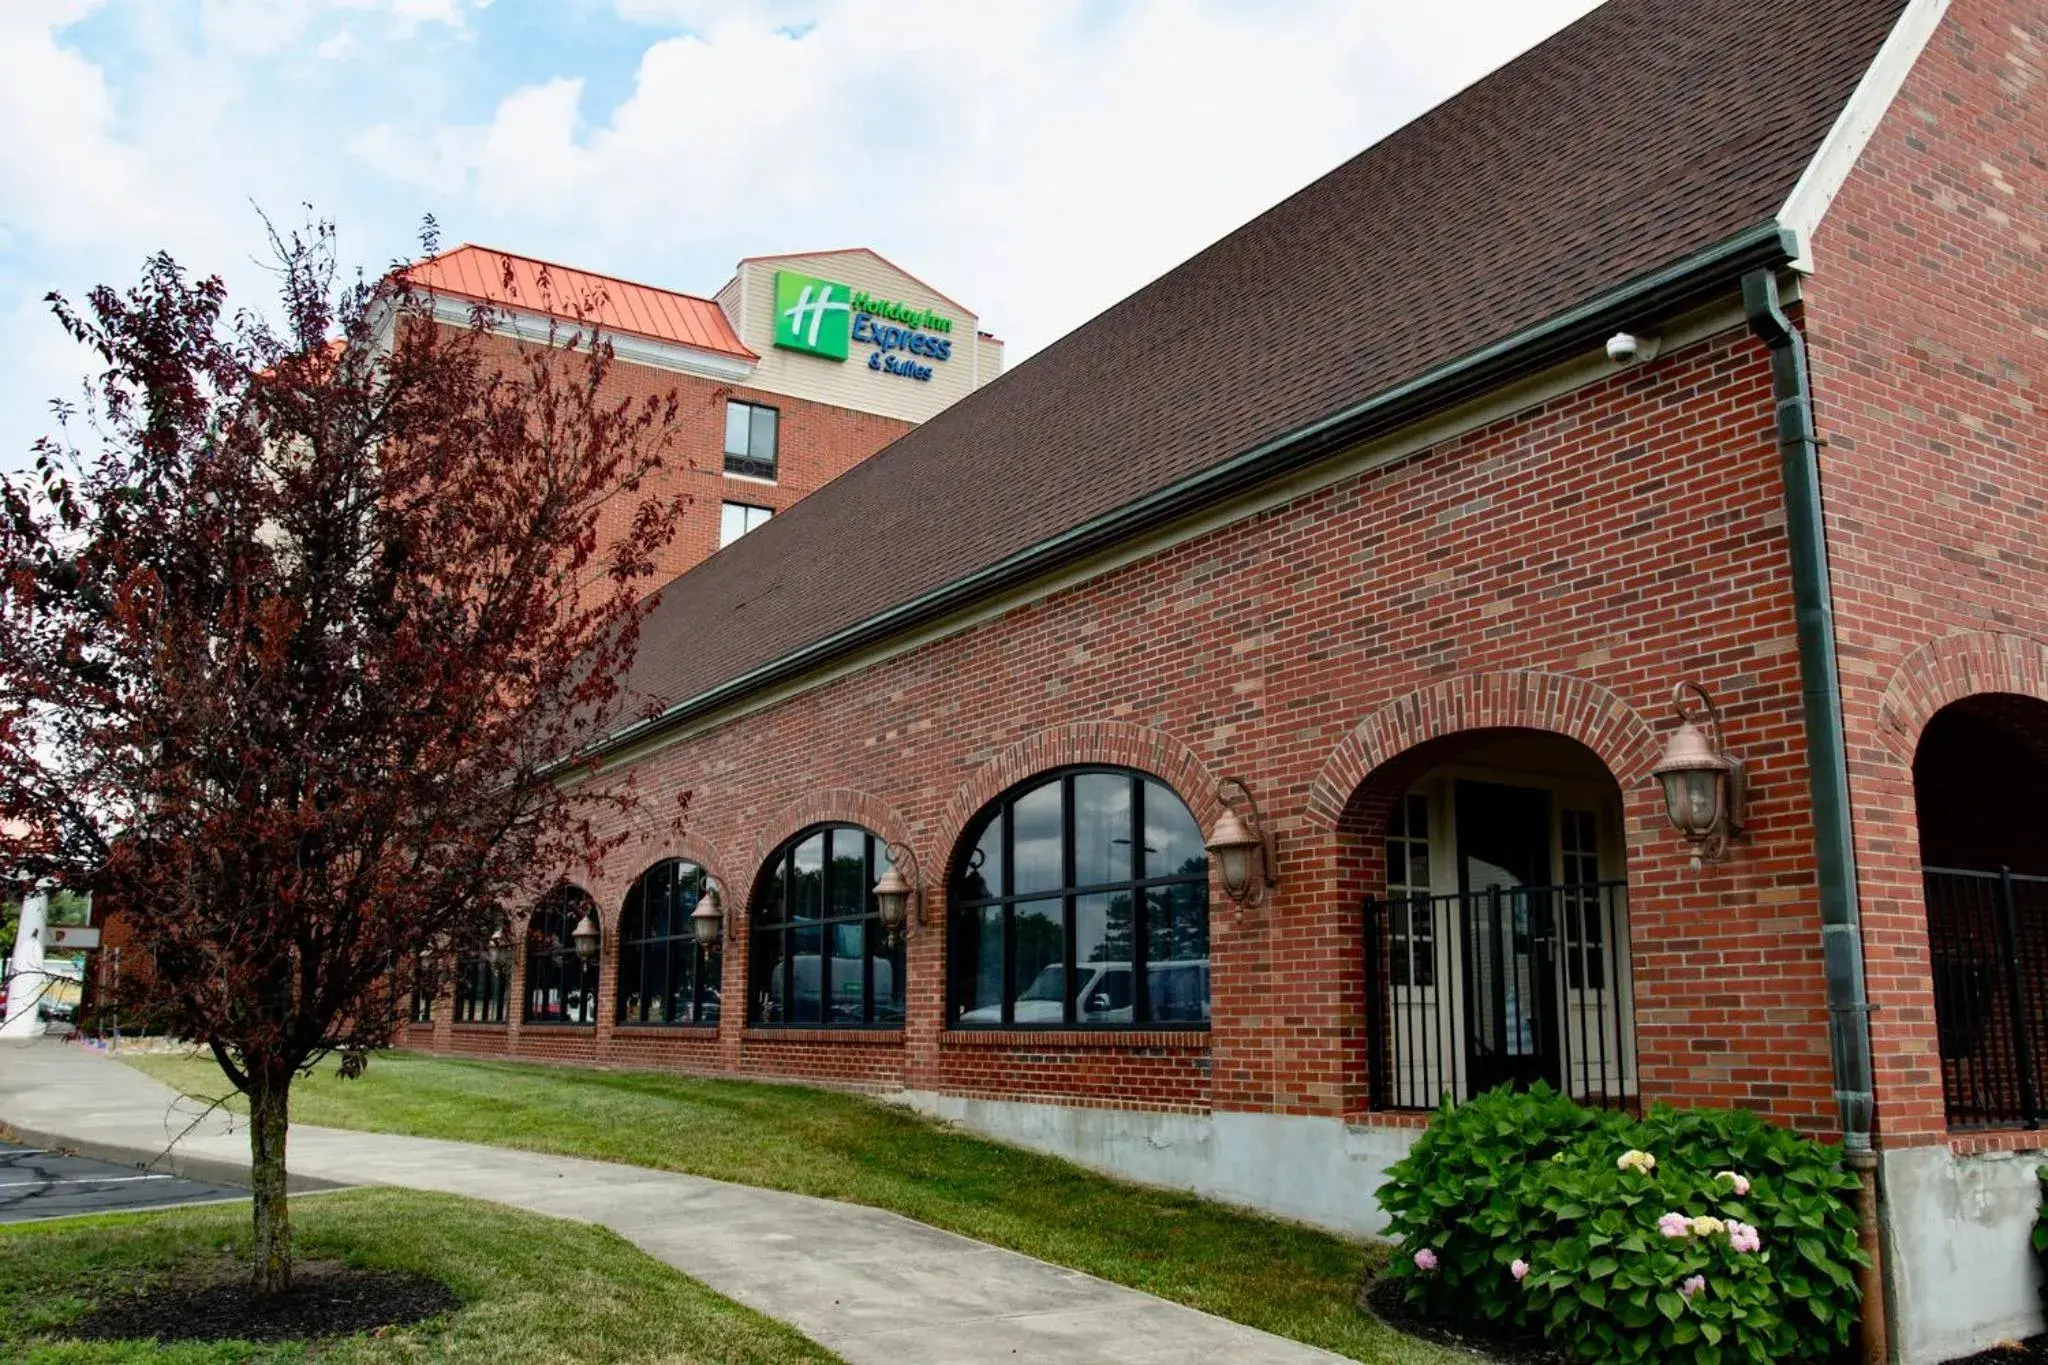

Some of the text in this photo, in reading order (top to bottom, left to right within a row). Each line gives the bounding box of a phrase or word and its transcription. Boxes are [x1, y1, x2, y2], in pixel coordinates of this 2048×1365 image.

[852, 292, 953, 333] Holiday Inn
[851, 314, 952, 361] Express
[868, 352, 933, 382] & Suites
